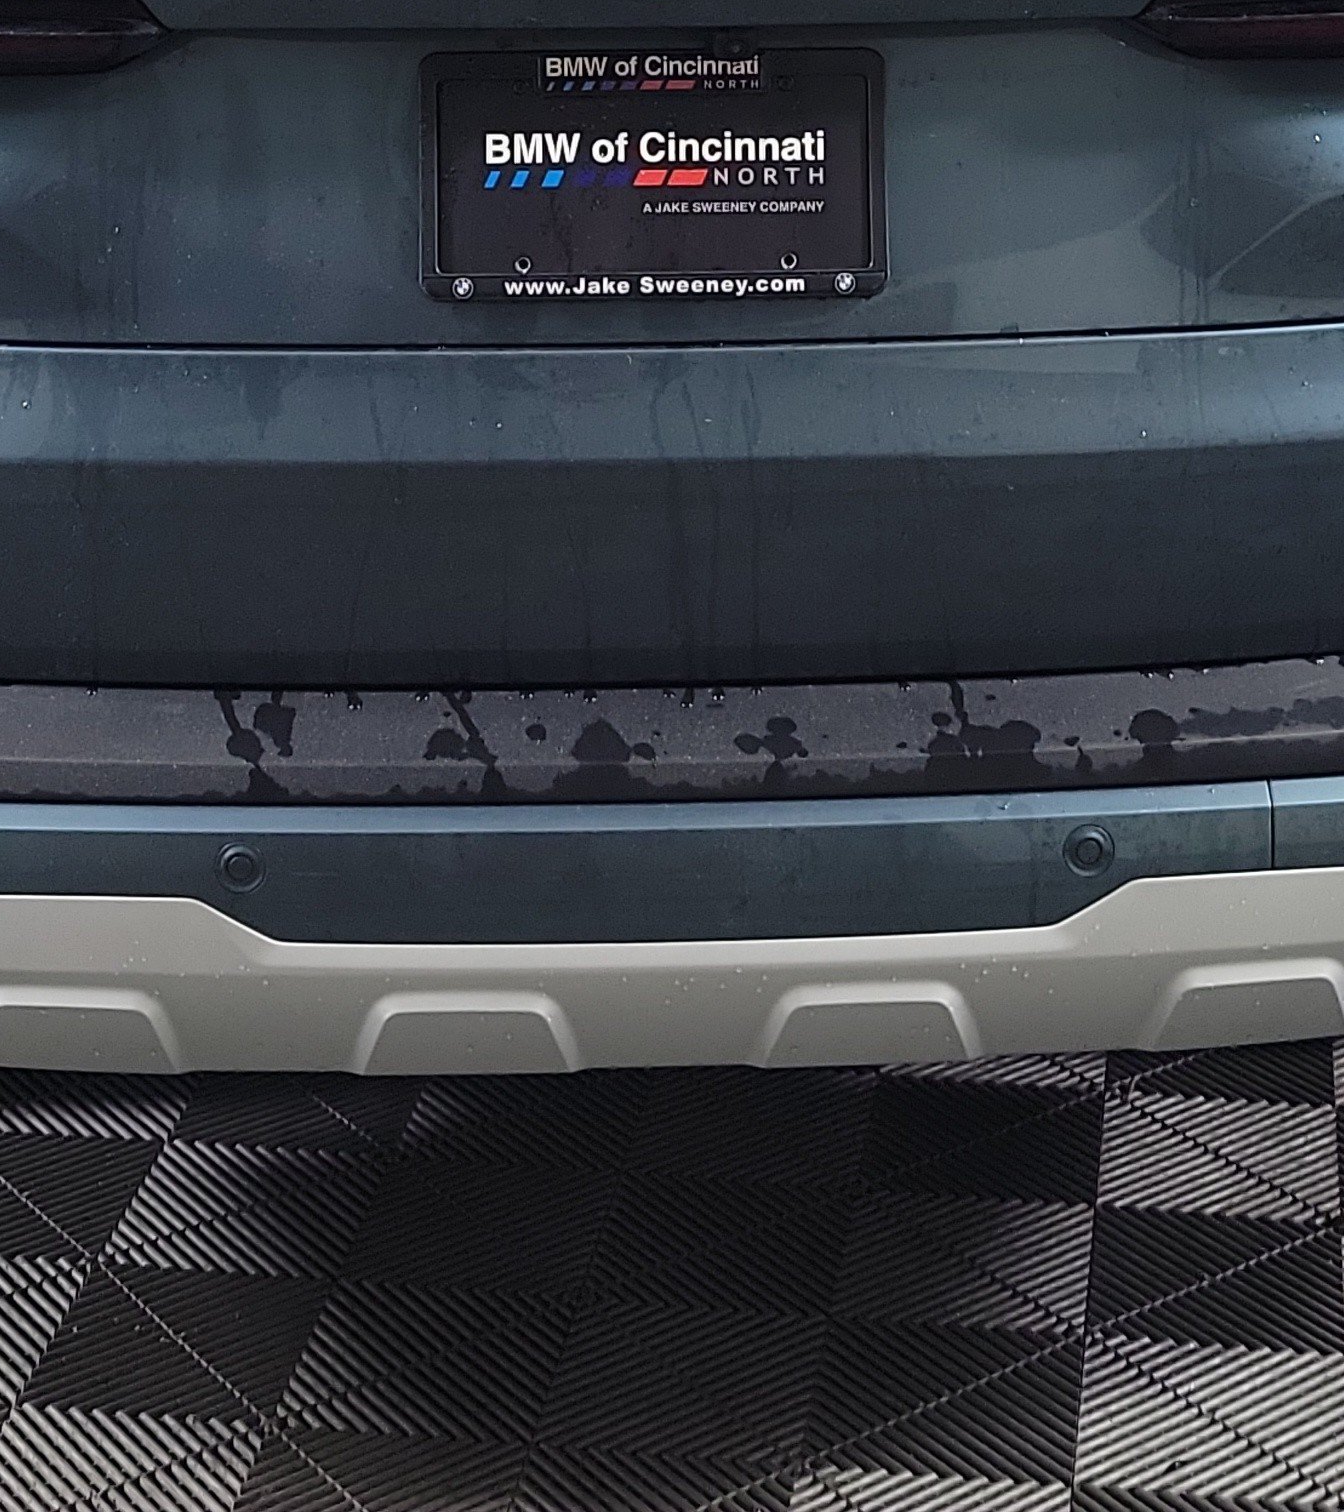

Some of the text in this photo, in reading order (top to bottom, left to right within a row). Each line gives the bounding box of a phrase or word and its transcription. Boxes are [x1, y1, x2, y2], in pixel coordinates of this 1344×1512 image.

[545, 55, 759, 77] BMW of Cincinnati
[703, 80, 759, 89] NORTH
[485, 130, 825, 165] BMW of Cincinnati
[713, 167, 825, 186] NORTH
[642, 201, 825, 213] A JAKE SWEENEY COMPANY
[504, 276, 805, 297] www.Jake Sweeney.com
